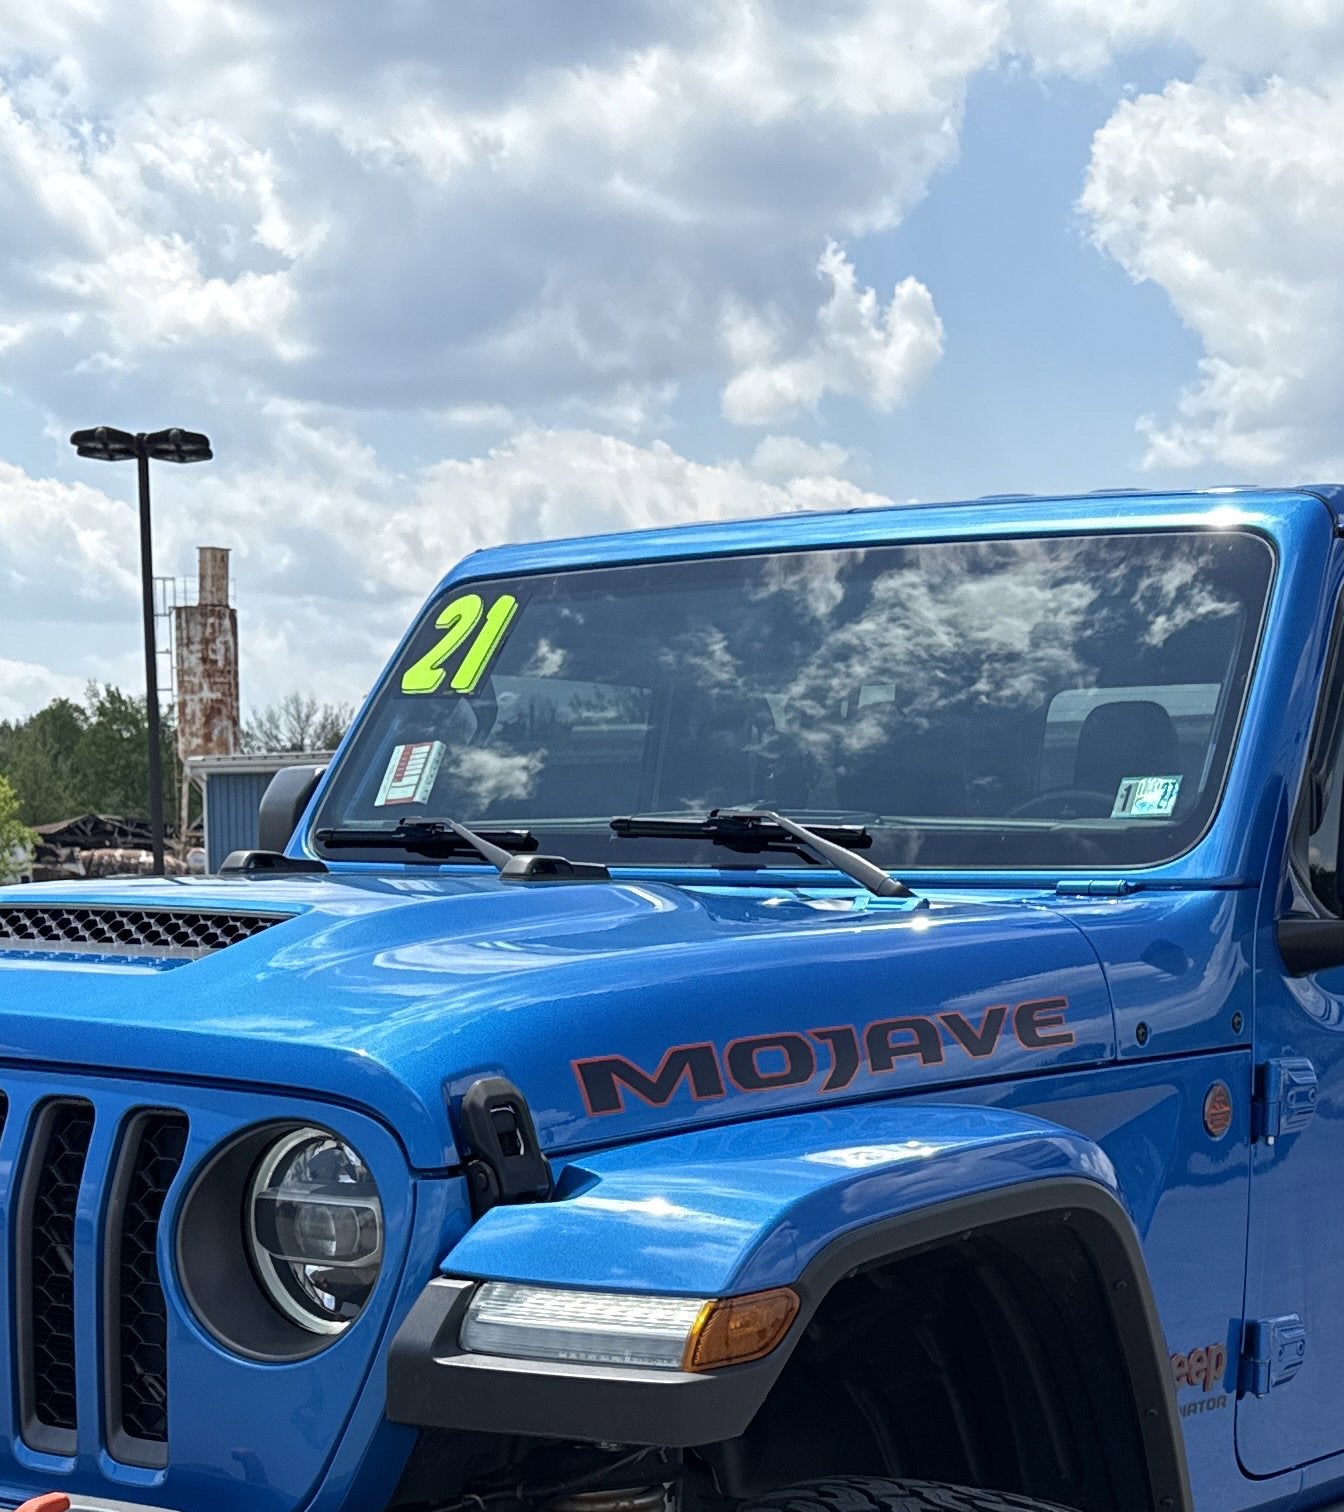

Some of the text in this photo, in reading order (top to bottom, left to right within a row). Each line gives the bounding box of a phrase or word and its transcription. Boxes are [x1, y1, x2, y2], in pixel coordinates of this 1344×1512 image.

[401, 594, 518, 694] 21
[571, 997, 1075, 1117] MOJAVE
[1170, 1342, 1227, 1392] eep
[1179, 1395, 1227, 1418] IATOR
